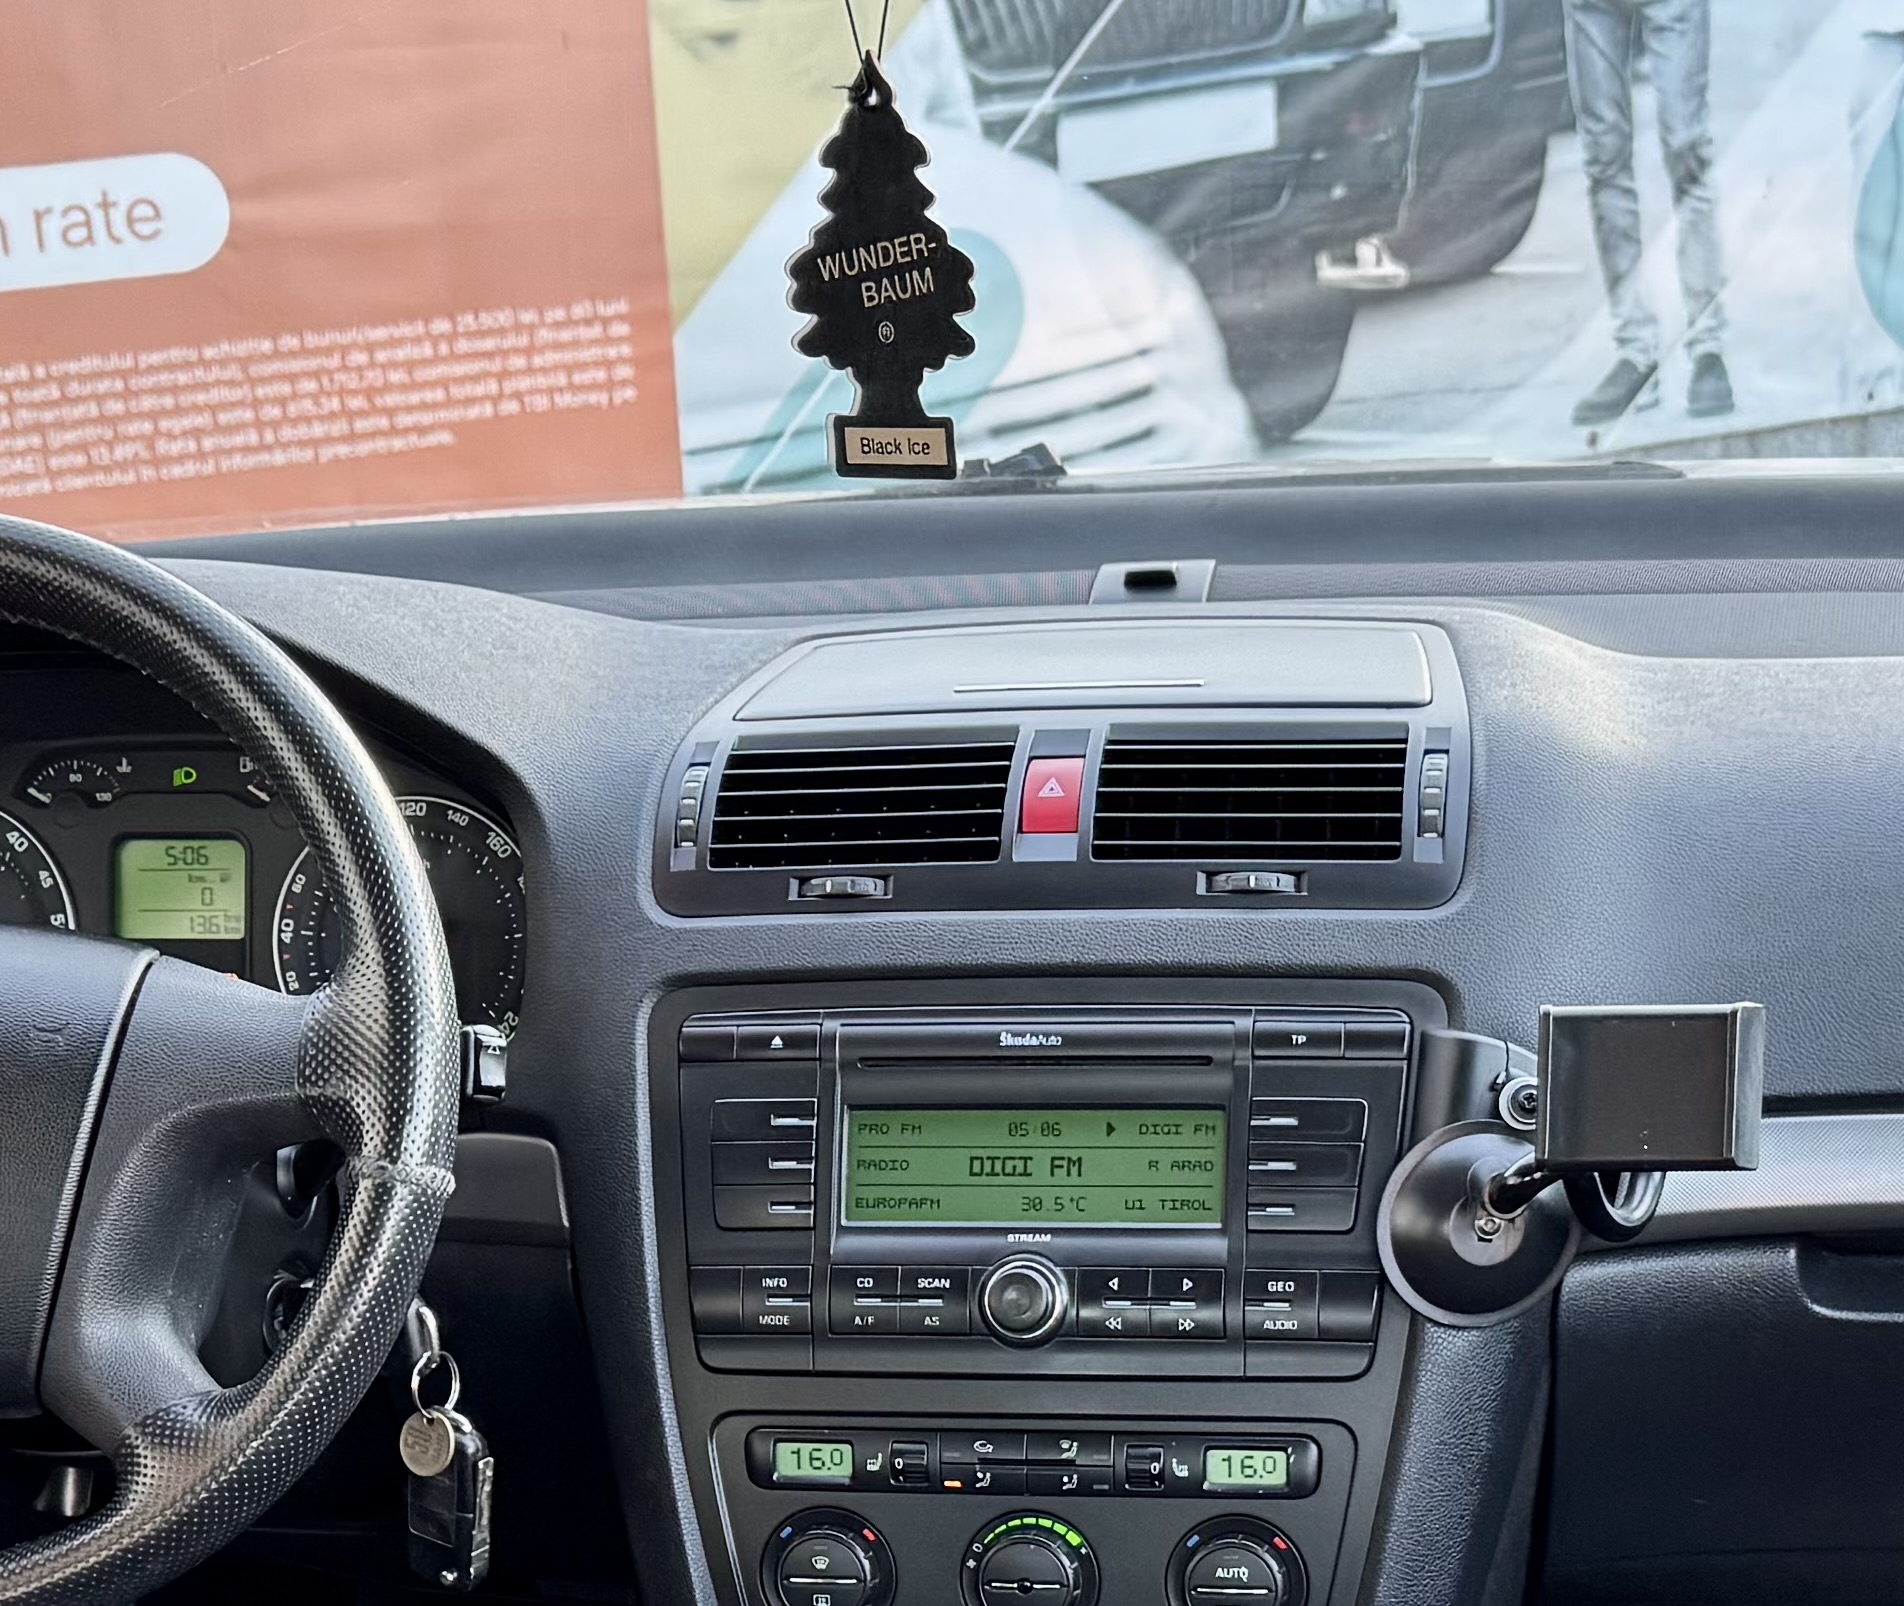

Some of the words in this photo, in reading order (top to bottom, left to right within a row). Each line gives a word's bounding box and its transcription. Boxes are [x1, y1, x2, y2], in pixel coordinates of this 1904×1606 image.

[32, 188, 164, 249] rate
[817, 232, 937, 282] WUNDER-
[861, 266, 934, 308] BAUM
[860, 437, 903, 455] Black
[907, 437, 931, 455] Ice
[400, 802, 427, 817] 120
[446, 810, 470, 828] 140
[5, 830, 29, 853] 40
[484, 831, 512, 859] 160
[38, 869, 53, 889] 45
[280, 918, 295, 944] 40
[285, 970, 300, 992] 20
[1291, 1035, 1307, 1045] TP
[857, 1122, 890, 1135] PRO
[900, 1122, 922, 1135] FM
[1138, 1124, 1183, 1136] DIGI
[1193, 1124, 1217, 1136] FM
[856, 1159, 910, 1171] RADIO
[969, 1156, 1033, 1177] DIGI
[1050, 1156, 1083, 1177] FM
[1147, 1160, 1160, 1172] R
[1170, 1160, 1214, 1172] ARAD
[855, 1197, 940, 1210] EUROPAFM
[1124, 1199, 1146, 1211] U1
[1159, 1199, 1213, 1211] TIROL
[762, 1276, 788, 1288] INFO
[856, 1277, 873, 1288] CD
[917, 1278, 950, 1289] SCAN
[1267, 1281, 1294, 1292] GEO
[759, 1315, 790, 1326] MODE
[853, 1315, 875, 1327] A/F
[923, 1316, 940, 1327] AS
[1263, 1319, 1298, 1331] AUDIO
[790, 1448, 844, 1472] 16.0
[1221, 1455, 1278, 1479] 16.0
